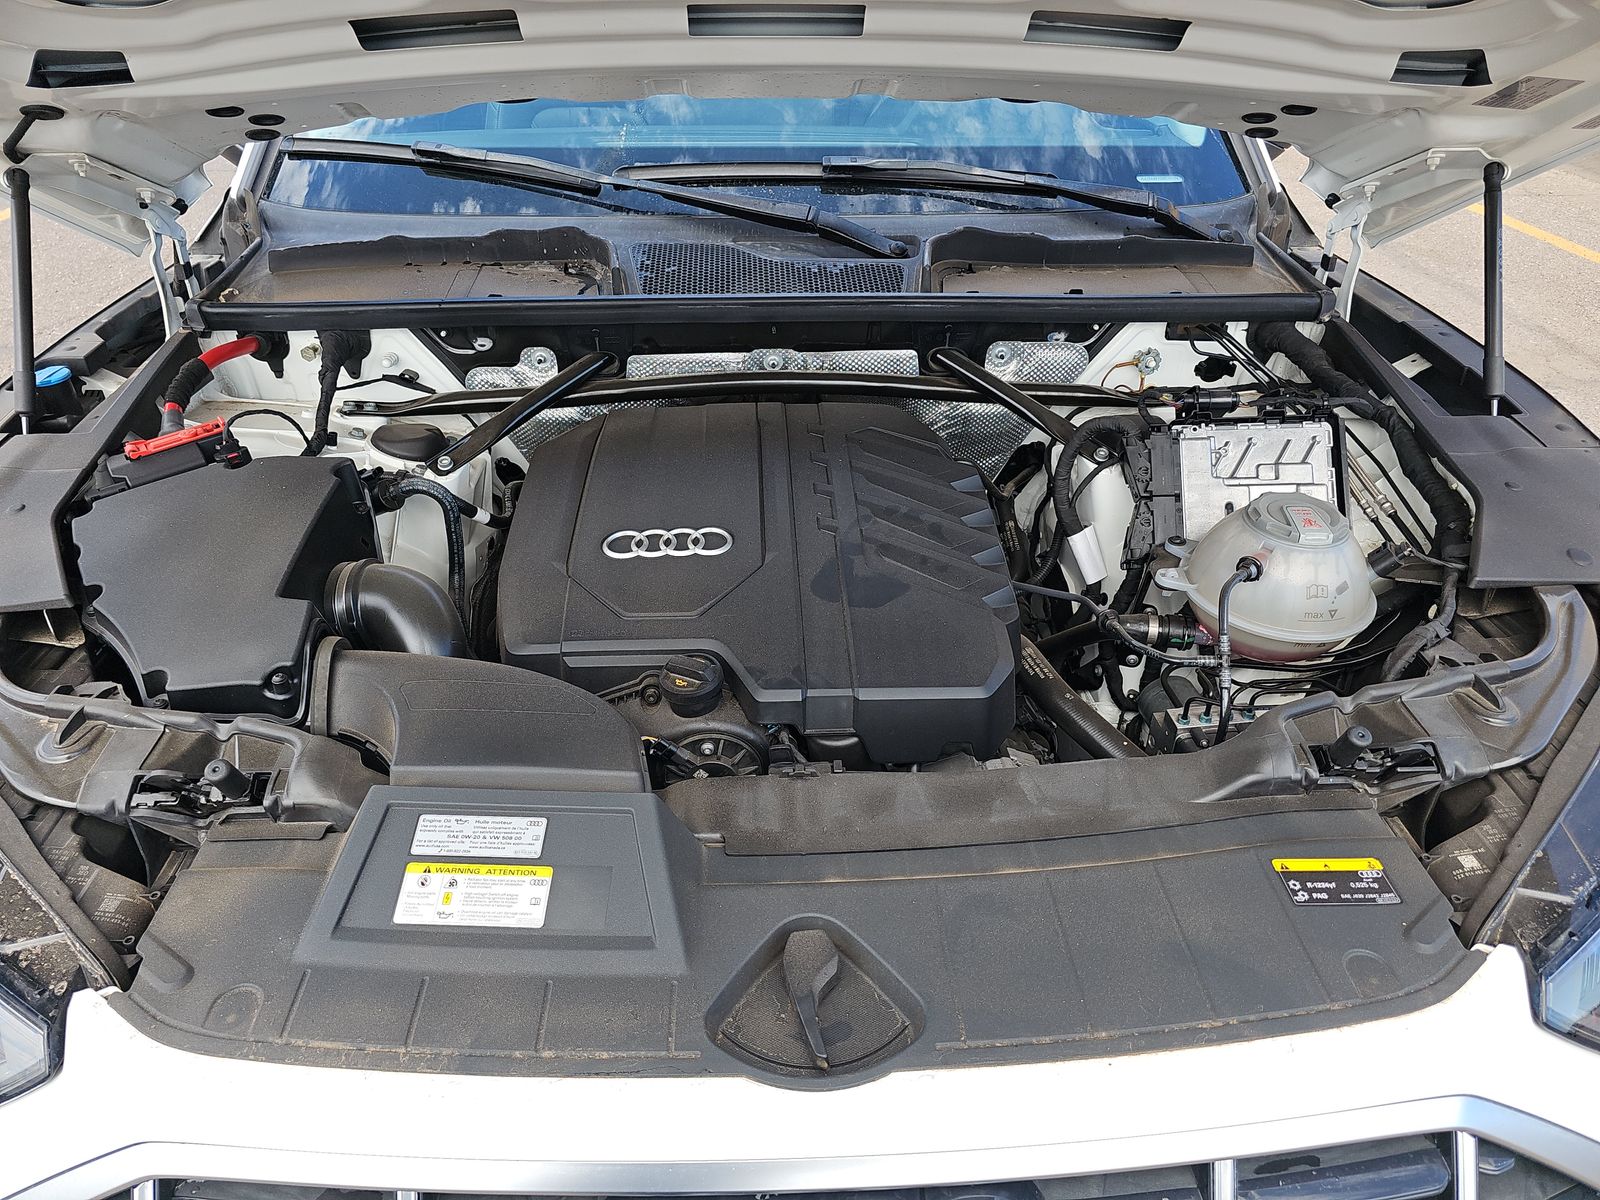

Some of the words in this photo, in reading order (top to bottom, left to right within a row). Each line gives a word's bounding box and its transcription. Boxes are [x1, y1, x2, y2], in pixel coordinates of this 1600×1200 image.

[435, 867, 481, 875] WARNING
[485, 868, 537, 876] ATTENTION
[1311, 892, 1329, 900] PAG
